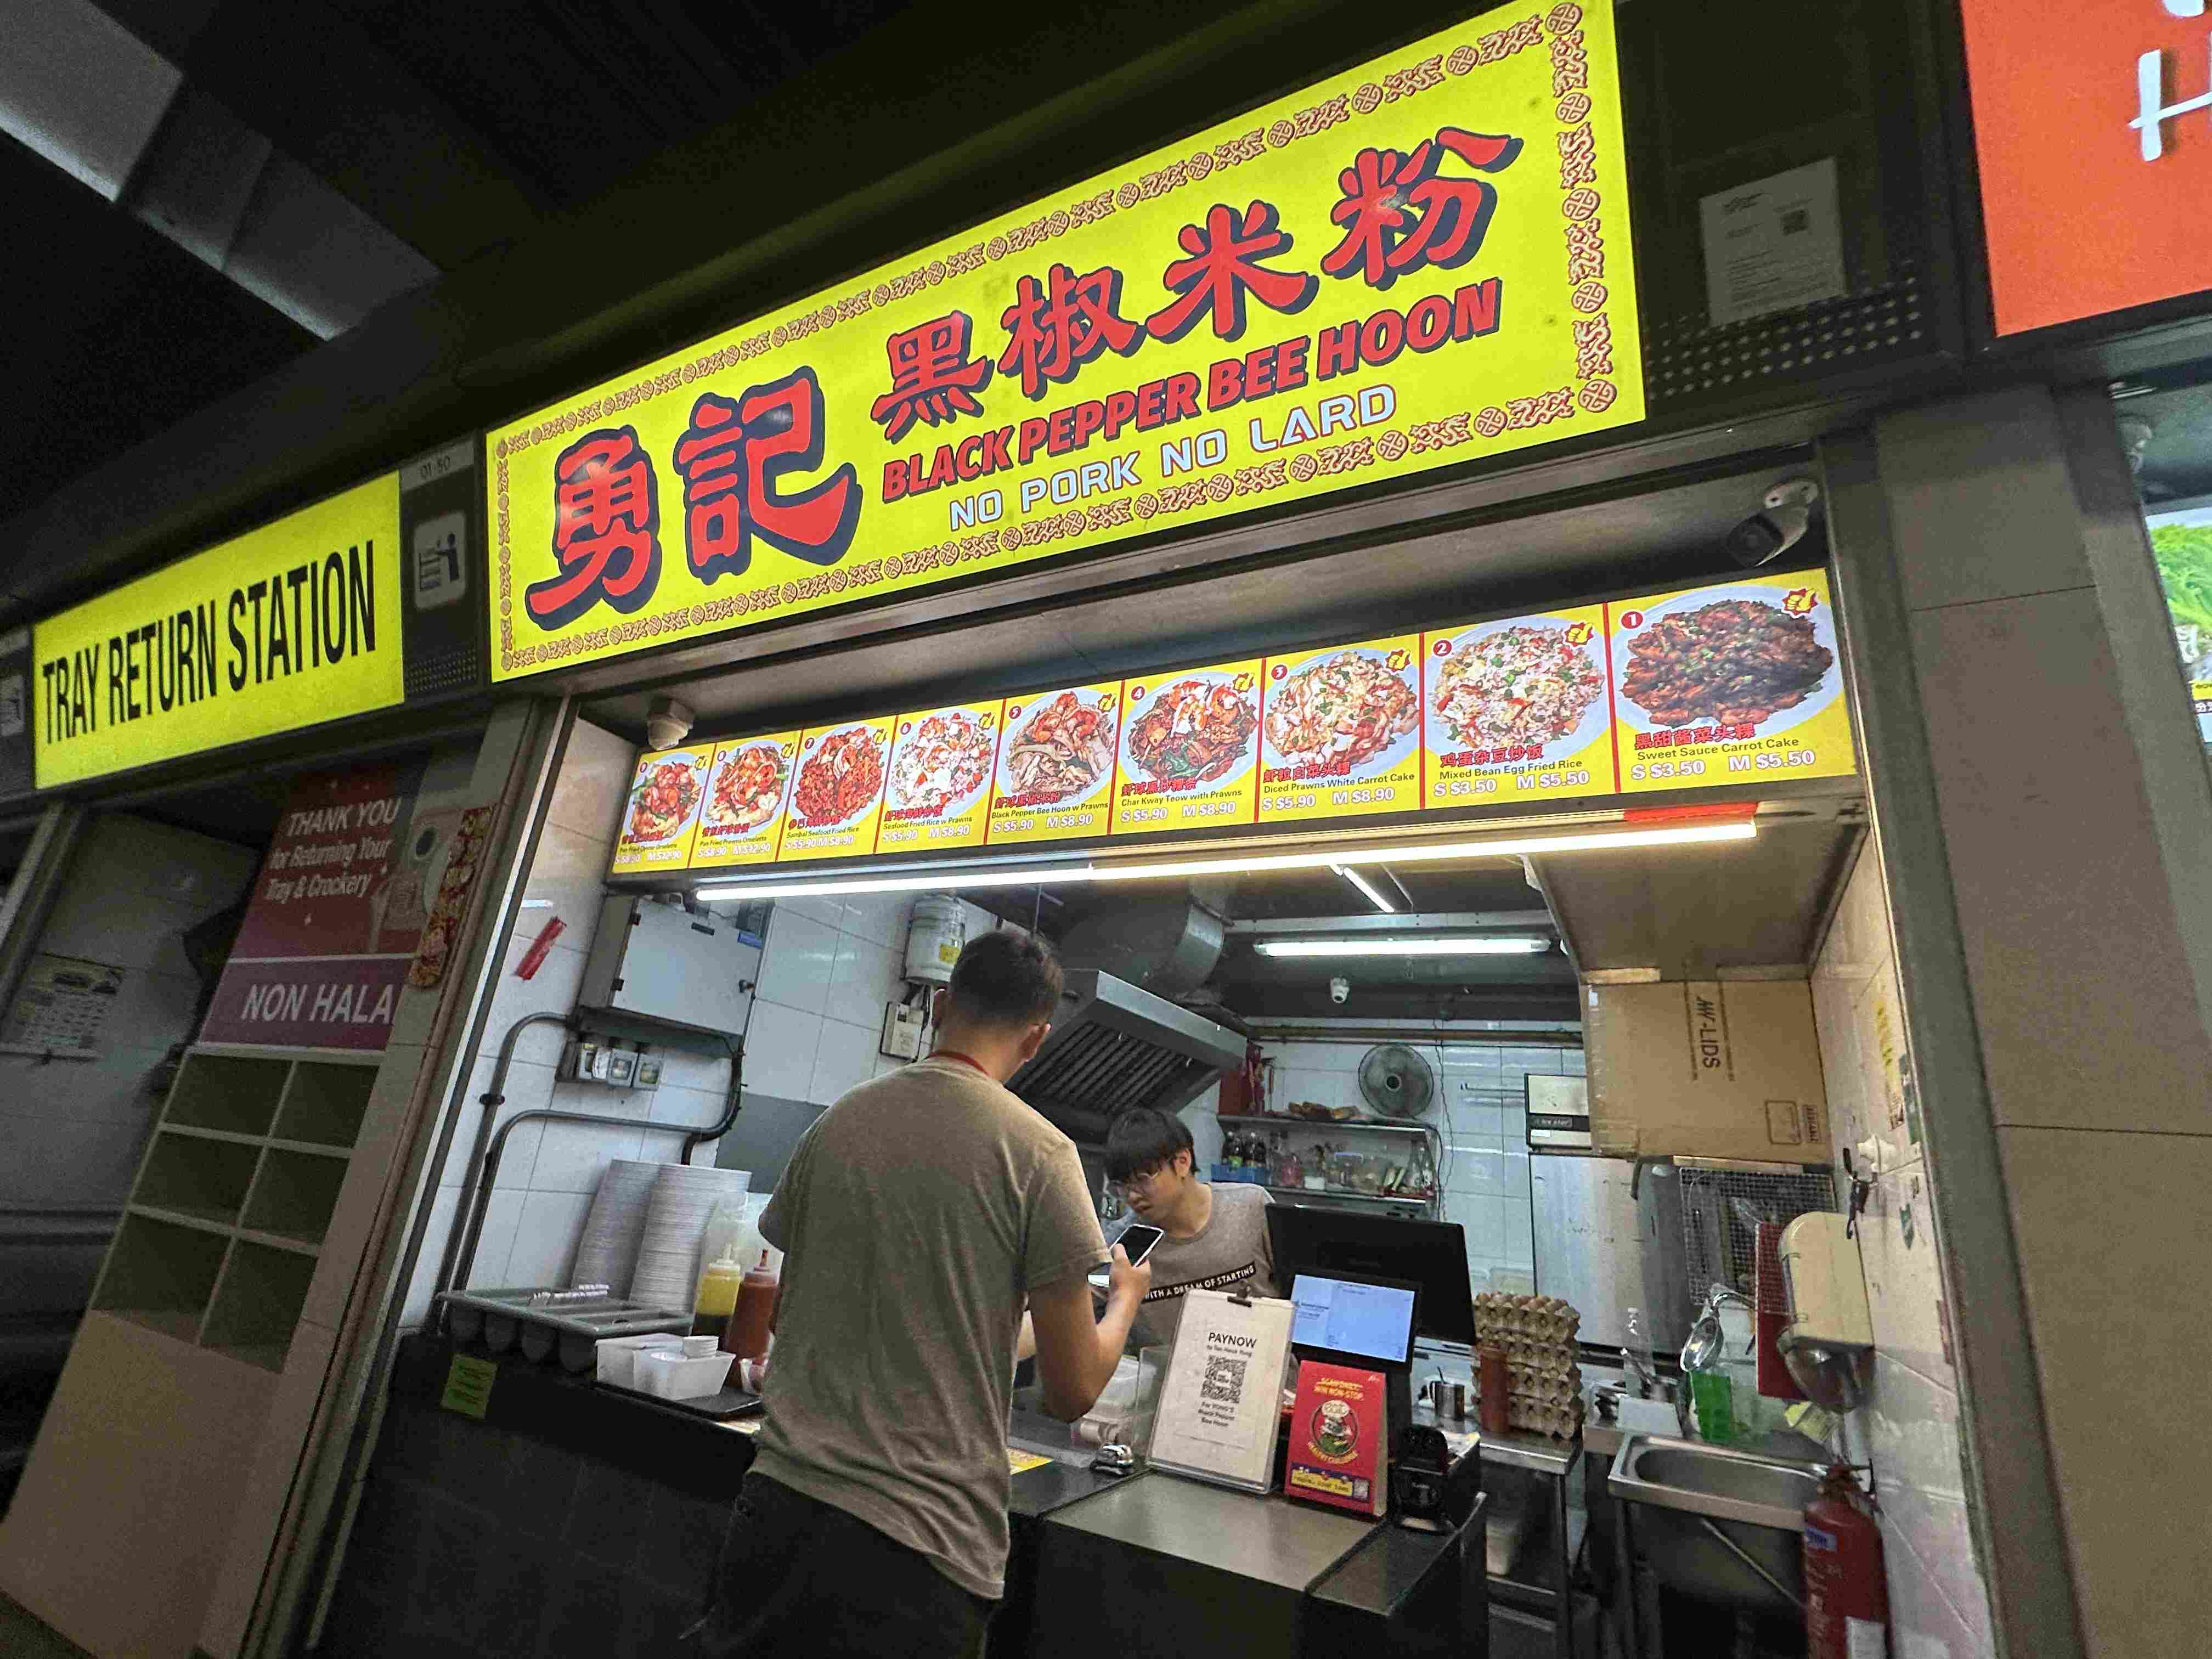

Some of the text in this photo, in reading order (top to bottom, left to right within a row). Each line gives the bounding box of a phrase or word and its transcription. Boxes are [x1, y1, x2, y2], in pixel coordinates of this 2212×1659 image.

[871, 126, 1523, 443] 黑椒米粉
[882, 276, 1503, 503] BLACK PEPPER BEE HOON
[949, 384, 1397, 531] NO PORK NO LARD
[525, 366, 863, 631] 勇記
[42, 539, 376, 744] TRAY RETURN STATION
[1634, 722, 1756, 751] 黑甜酱菜头粿
[1638, 738, 1799, 760] Sweet Sauce Carrot Cake
[1440, 743, 1544, 769] 鸡蛋杂豆炒饭
[1631, 749, 1815, 781] S $3.50 M $5.50
[1440, 759, 1583, 780] Mixed Bean Egg Fried Rice
[1264, 773, 1415, 794] Diced Prawns White Carrot Cake
[1434, 770, 1590, 798] S $3.50 M $5.50
[1121, 799, 1138, 807] Char
[1142, 797, 1164, 805] Kway
[1190, 792, 1207, 800] with
[1210, 789, 1242, 798] Prawns
[1262, 787, 1395, 811] S $5.90 M $8.90
[287, 798, 400, 837] THANK YOU
[1003, 819, 1034, 832] $5.90
[1046, 816, 1059, 828] M
[1060, 813, 1093, 827] $8.90
[1011, 810, 1036, 818] Pepper
[1121, 802, 1235, 822] S $5.90 M $8.90
[883, 822, 909, 830] Seafood
[358, 835, 392, 862] Your
[241, 984, 308, 1022] NON
[1204, 1279, 1215, 1288] OF
[1217, 1265, 1254, 1285] STARTING
[1209, 1332, 1257, 1348] PAYNOW
